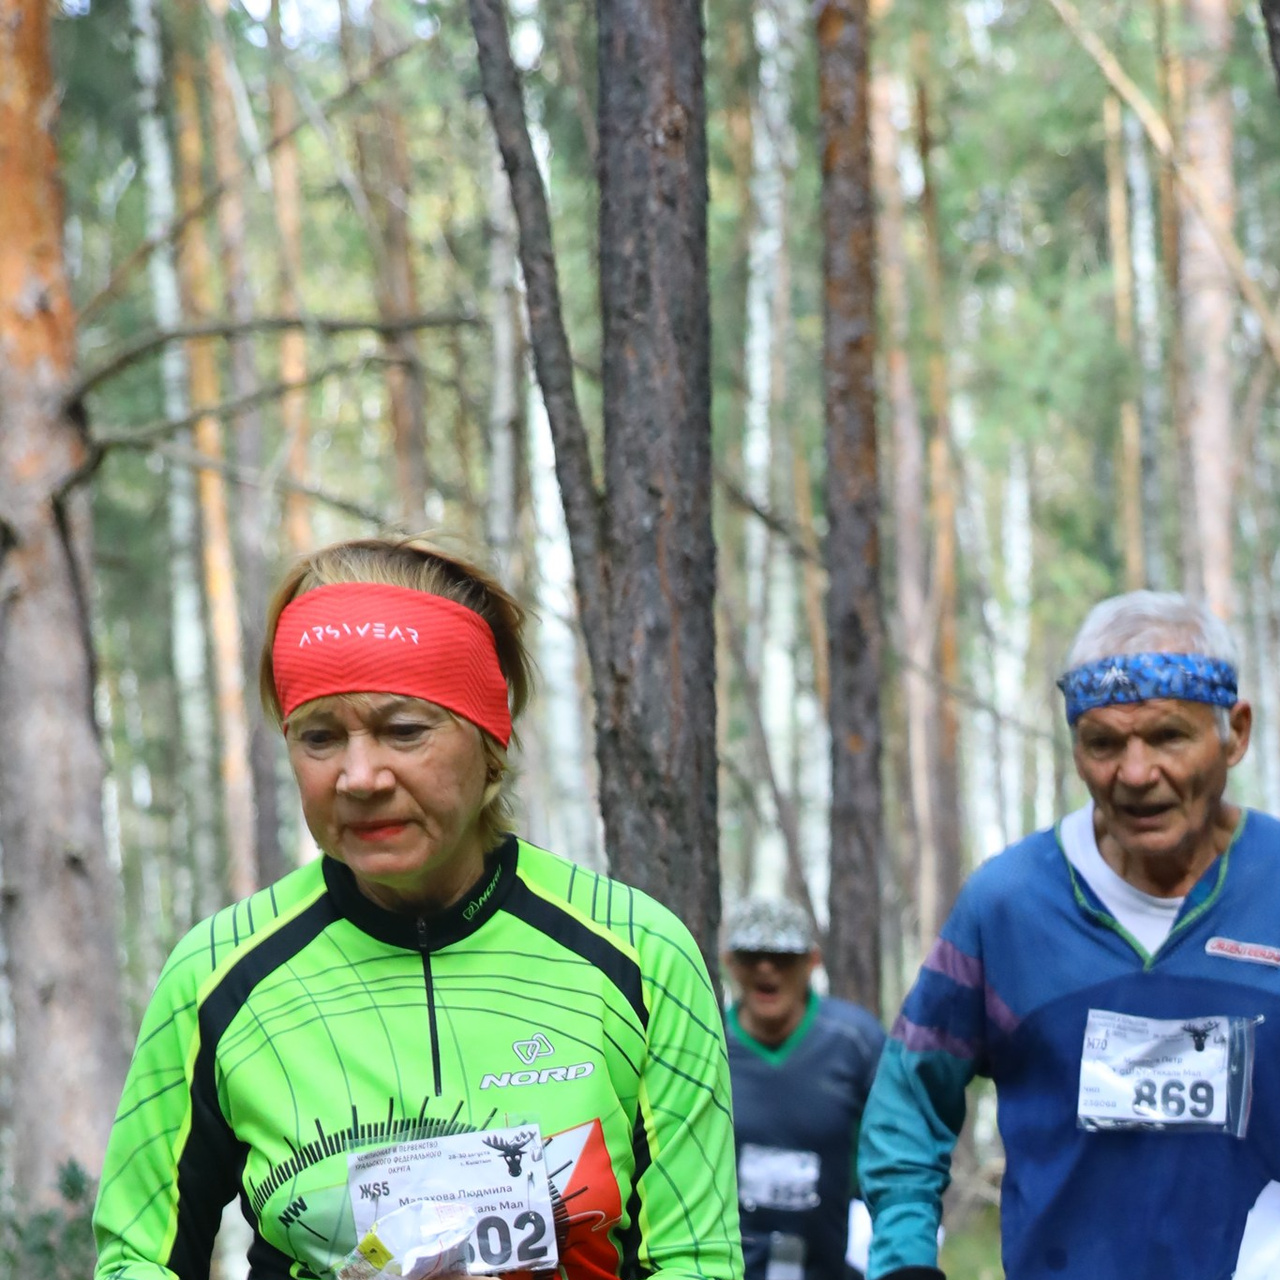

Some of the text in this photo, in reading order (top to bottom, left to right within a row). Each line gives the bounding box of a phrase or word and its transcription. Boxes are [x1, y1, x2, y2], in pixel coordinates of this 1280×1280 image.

[479, 1061, 596, 1090] NORD
[1132, 1078, 1215, 1118] 869
[400, 1141, 439, 1152] ПЕРВЕНСТВО
[394, 1150, 442, 1165] ФЕДЕРАЛЬНОГО
[388, 1165, 411, 1175] ОКРУГА
[457, 1185, 513, 1200] Людмила
[278, 1195, 308, 1228] NW
[499, 1201, 524, 1212] Мал
[466, 1210, 548, 1266] 02
